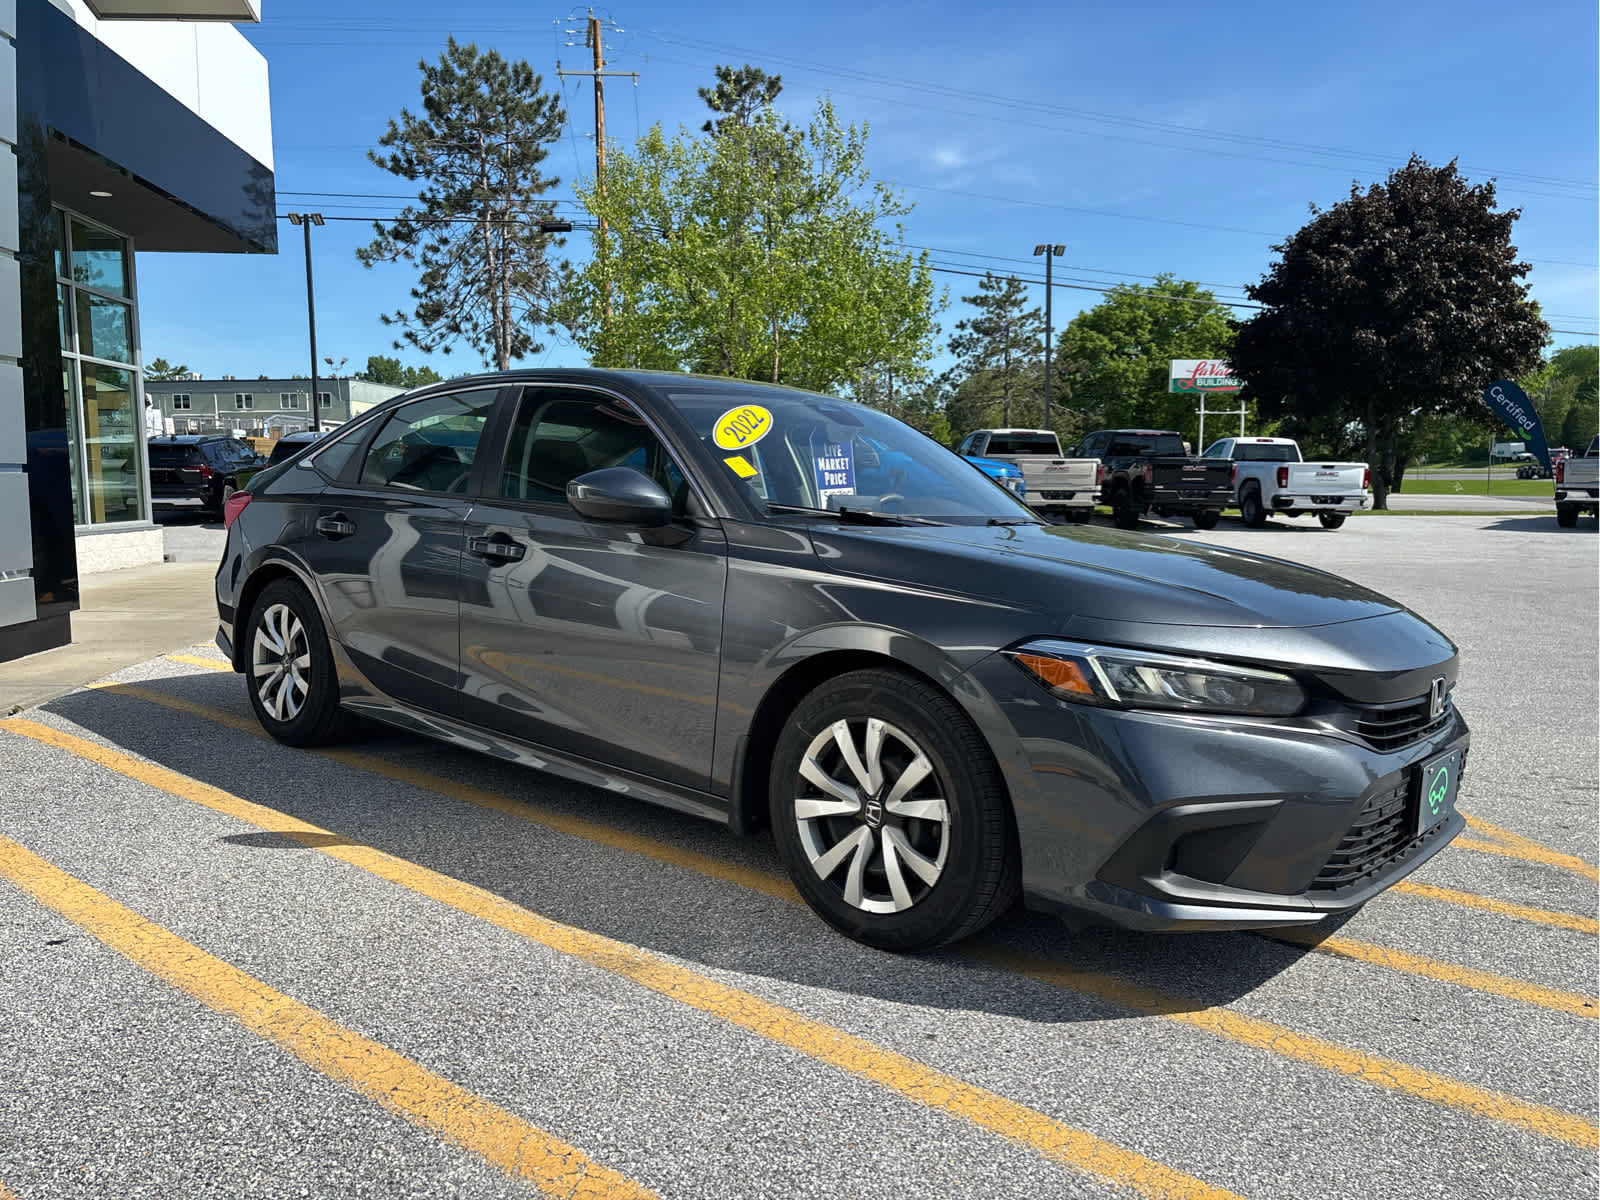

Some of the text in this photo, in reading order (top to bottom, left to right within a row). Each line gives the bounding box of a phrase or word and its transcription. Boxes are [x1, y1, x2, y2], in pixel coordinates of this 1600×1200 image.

[1490, 386, 1536, 430] Certified
[724, 409, 764, 443] 2022
[824, 444, 842, 457] LIVE
[818, 457, 849, 471] MARKET
[825, 472, 847, 486] PRICE
